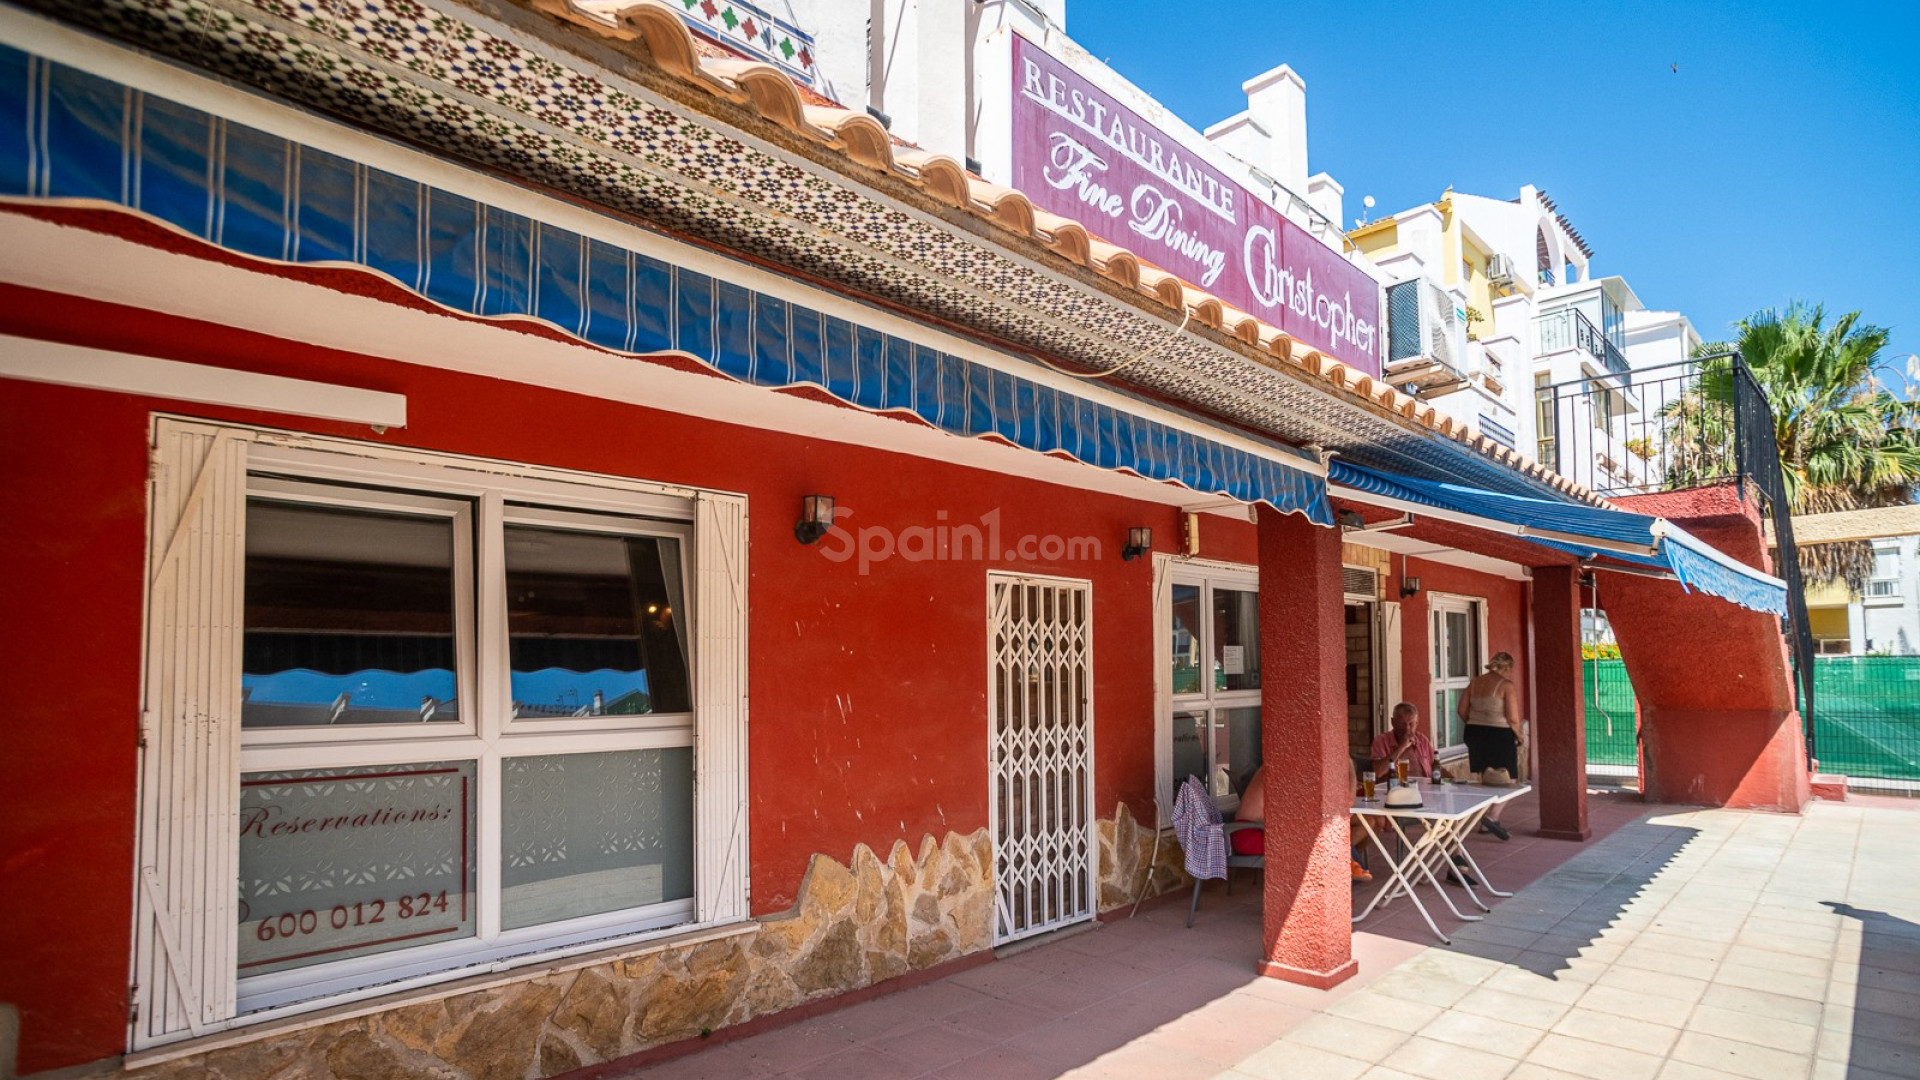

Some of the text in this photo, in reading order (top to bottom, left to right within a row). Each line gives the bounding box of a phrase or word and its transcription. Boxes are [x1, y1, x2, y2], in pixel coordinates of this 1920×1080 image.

[1021, 56, 1236, 216] RESTAURANTE
[1043, 131, 1226, 288] Fine Dining
[1243, 224, 1375, 357] Christopher
[240, 804, 452, 839] Reservations:
[257, 889, 449, 942] 600 012 824
